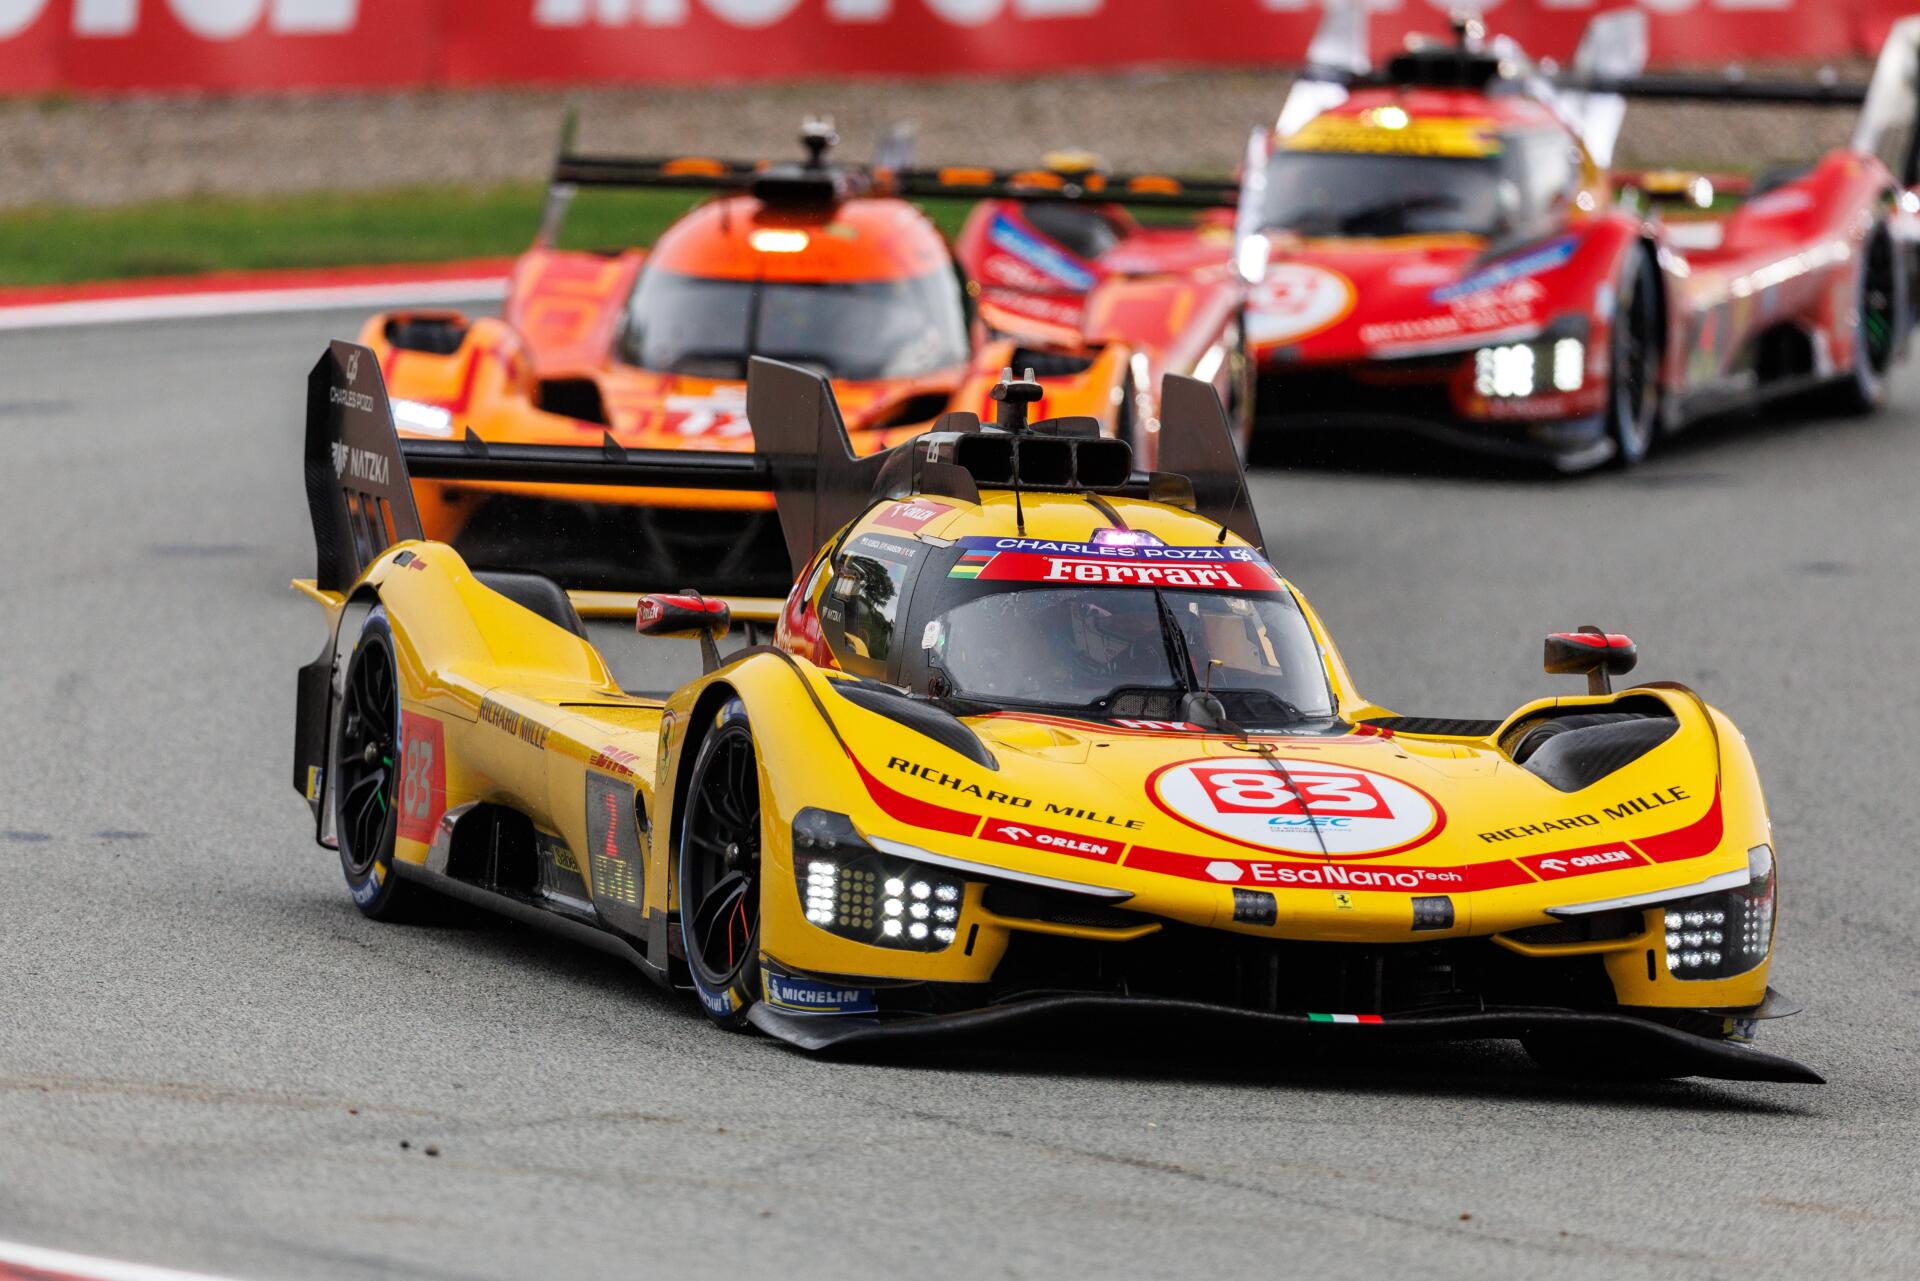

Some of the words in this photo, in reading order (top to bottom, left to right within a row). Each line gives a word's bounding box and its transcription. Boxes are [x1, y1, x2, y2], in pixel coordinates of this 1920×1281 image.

[350, 447, 390, 486] NATZKA
[995, 538, 1138, 558] CHARLES
[1145, 548, 1225, 560] POZZI
[1043, 557, 1242, 588] Ferrari
[479, 697, 521, 737] RICHARD
[518, 714, 550, 750] MILLE
[404, 737, 433, 820] 83
[887, 756, 1033, 809] RICHARD
[1044, 802, 1146, 831] MILLE
[1208, 772, 1378, 812] 83
[1268, 816, 1353, 827] WEC
[1478, 813, 1601, 844] RICHARD
[1602, 785, 1692, 821] MILLE
[1035, 834, 1109, 856] ORLEN
[1570, 850, 1632, 868] ORLEN
[782, 987, 861, 1003] MICHELIN
